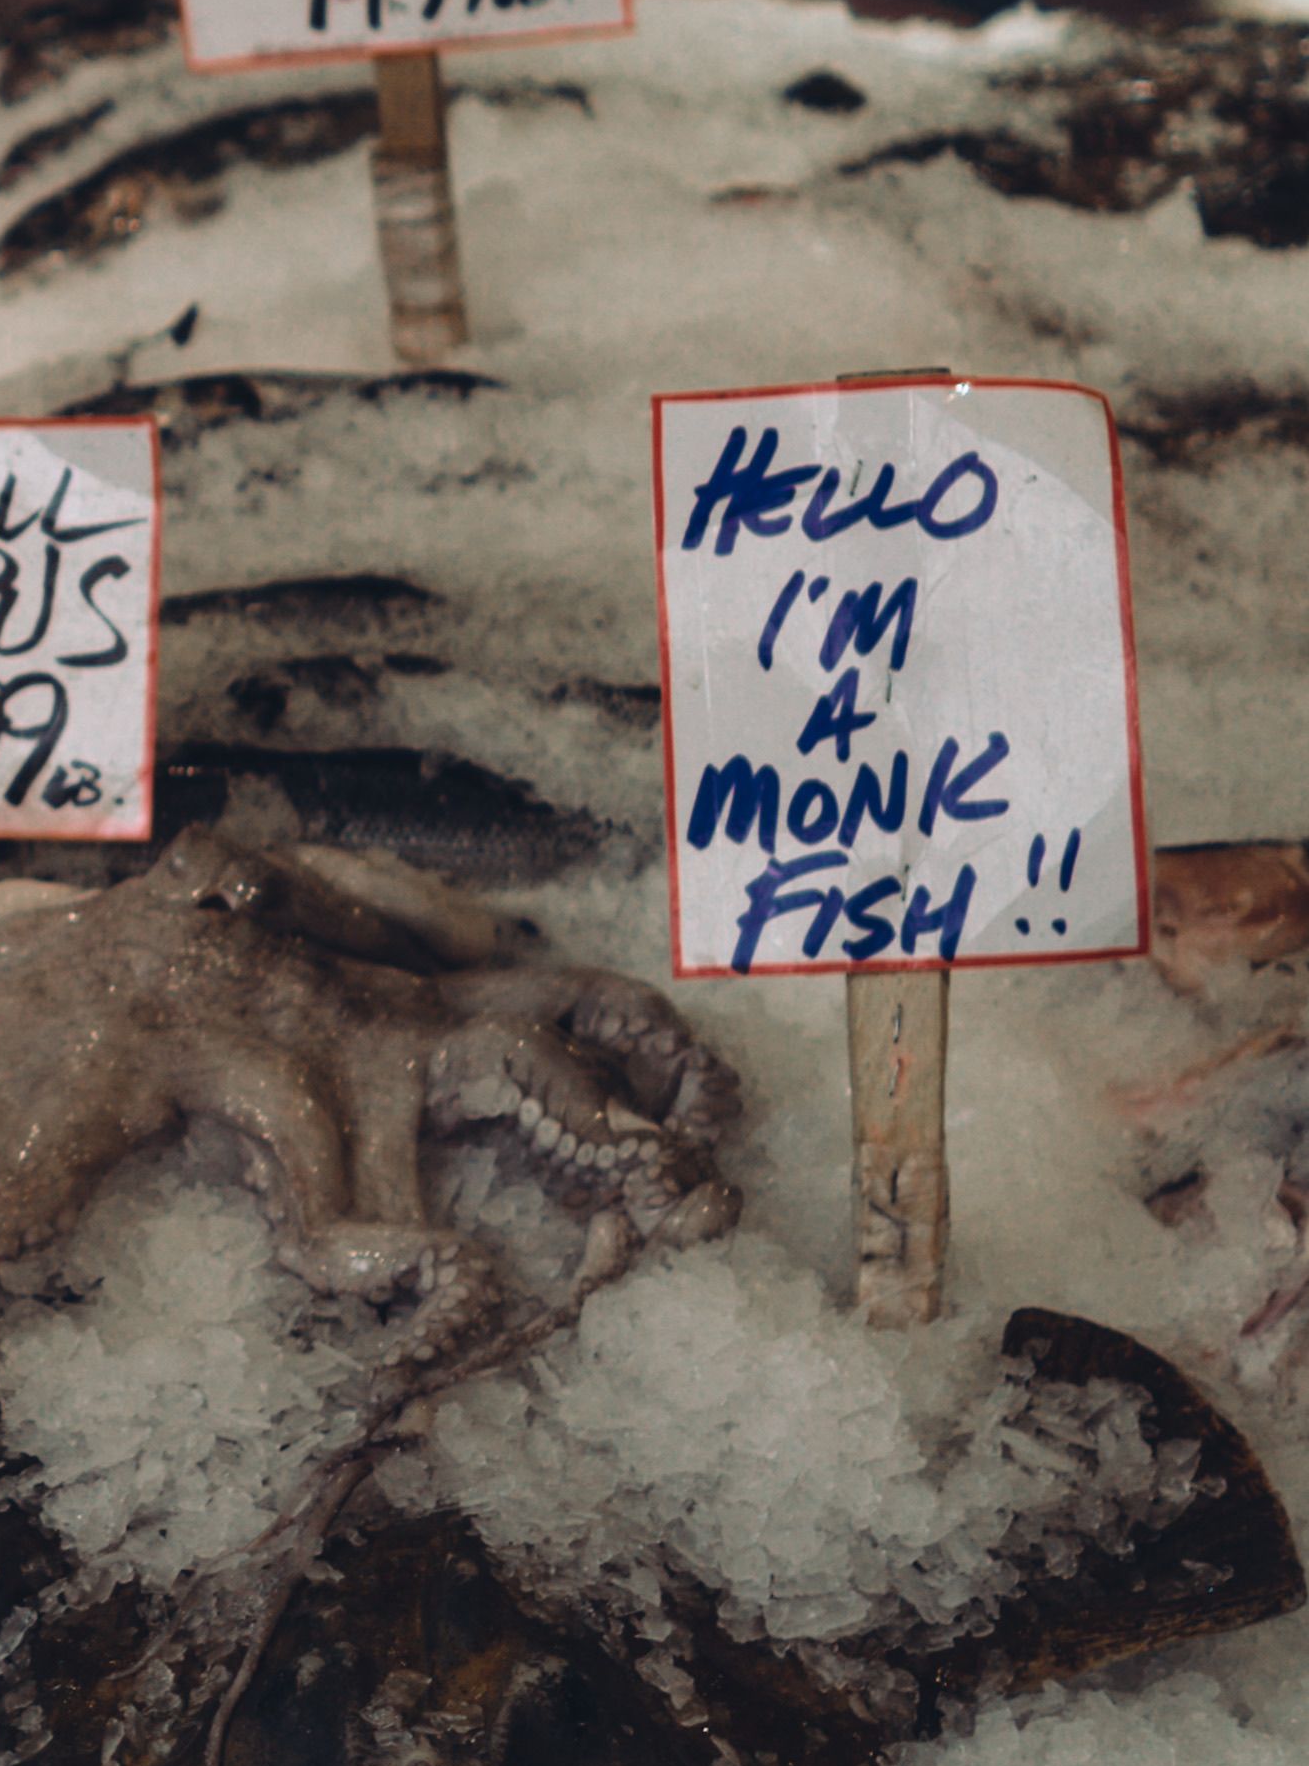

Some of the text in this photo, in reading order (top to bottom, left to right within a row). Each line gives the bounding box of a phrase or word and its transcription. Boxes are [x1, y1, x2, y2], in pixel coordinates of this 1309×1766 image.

[681, 425, 999, 556] HELLO
[757, 570, 919, 673] I'M
[796, 666, 877, 763] A
[686, 731, 1010, 854] MONK
